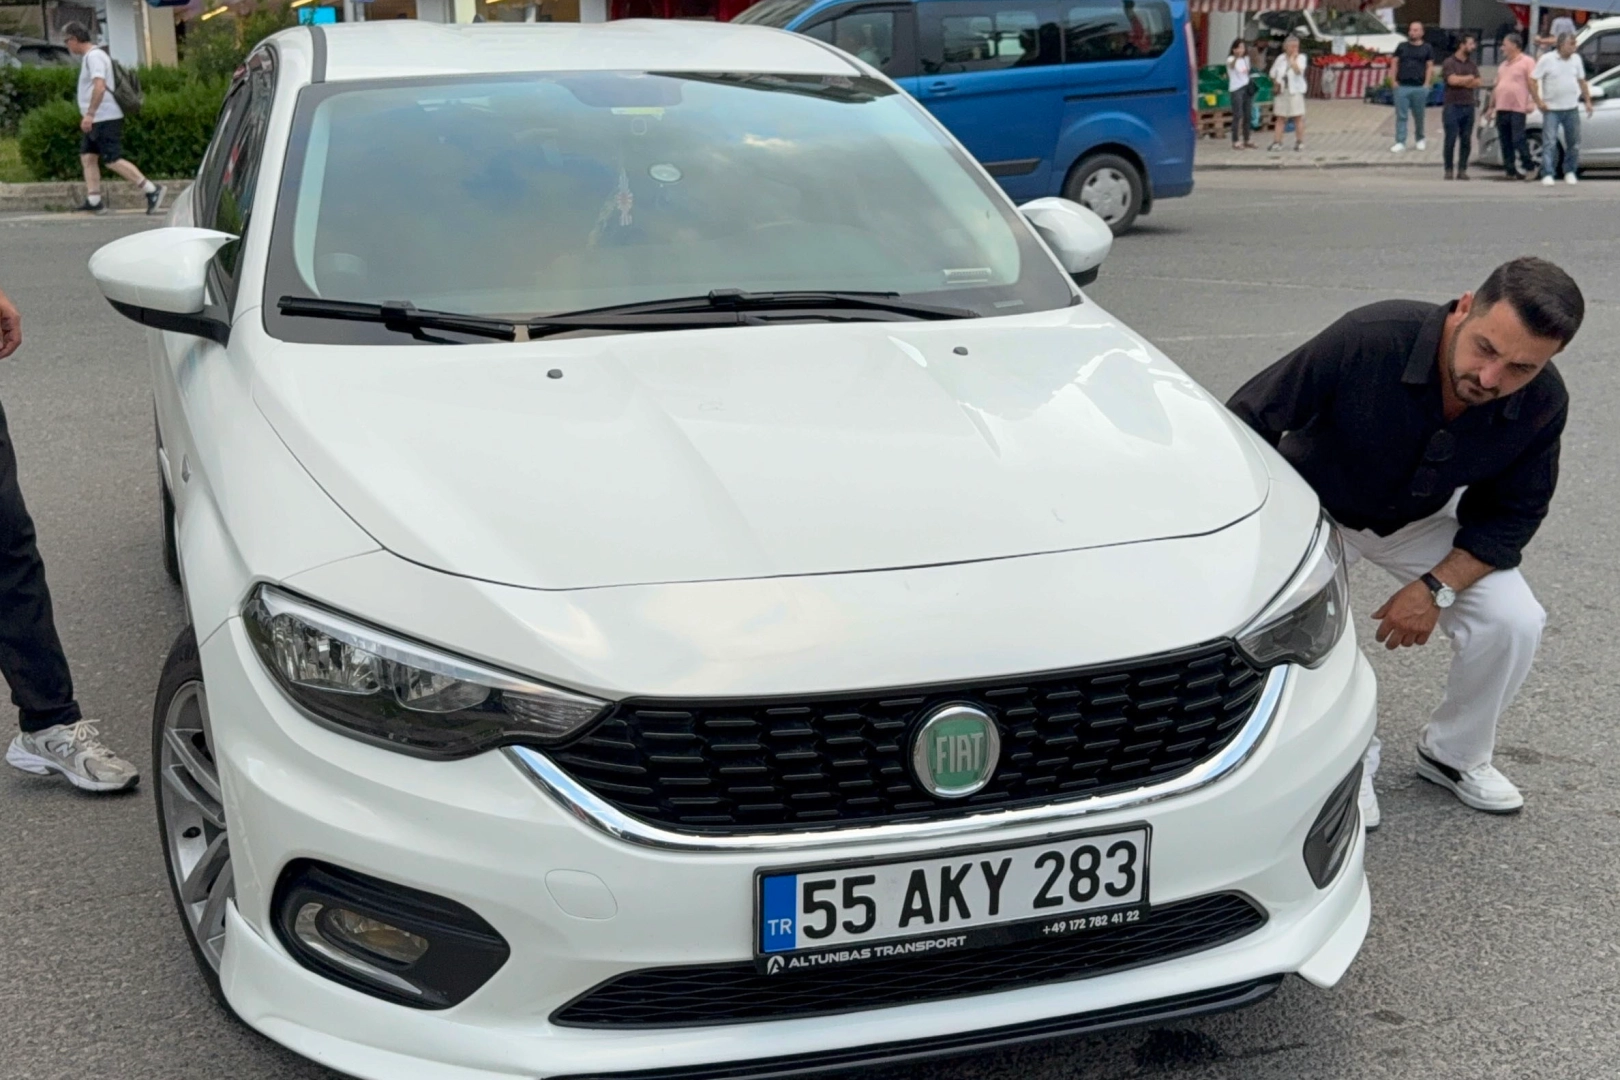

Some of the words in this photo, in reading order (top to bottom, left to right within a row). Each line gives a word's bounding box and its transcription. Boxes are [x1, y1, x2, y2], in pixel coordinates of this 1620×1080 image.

[936, 732, 984, 774] FIAT
[803, 875, 876, 939] 55
[898, 857, 1012, 928] AKY
[1033, 840, 1137, 909] 283
[767, 918, 793, 936] TR
[1042, 921, 1067, 935] +49
[1069, 918, 1086, 931] 172
[1089, 915, 1109, 928] 782
[1111, 912, 1123, 924] 41
[1126, 910, 1140, 922] 22
[788, 948, 871, 969] ALTUNBAS
[874, 935, 967, 957] TRANSPORT
